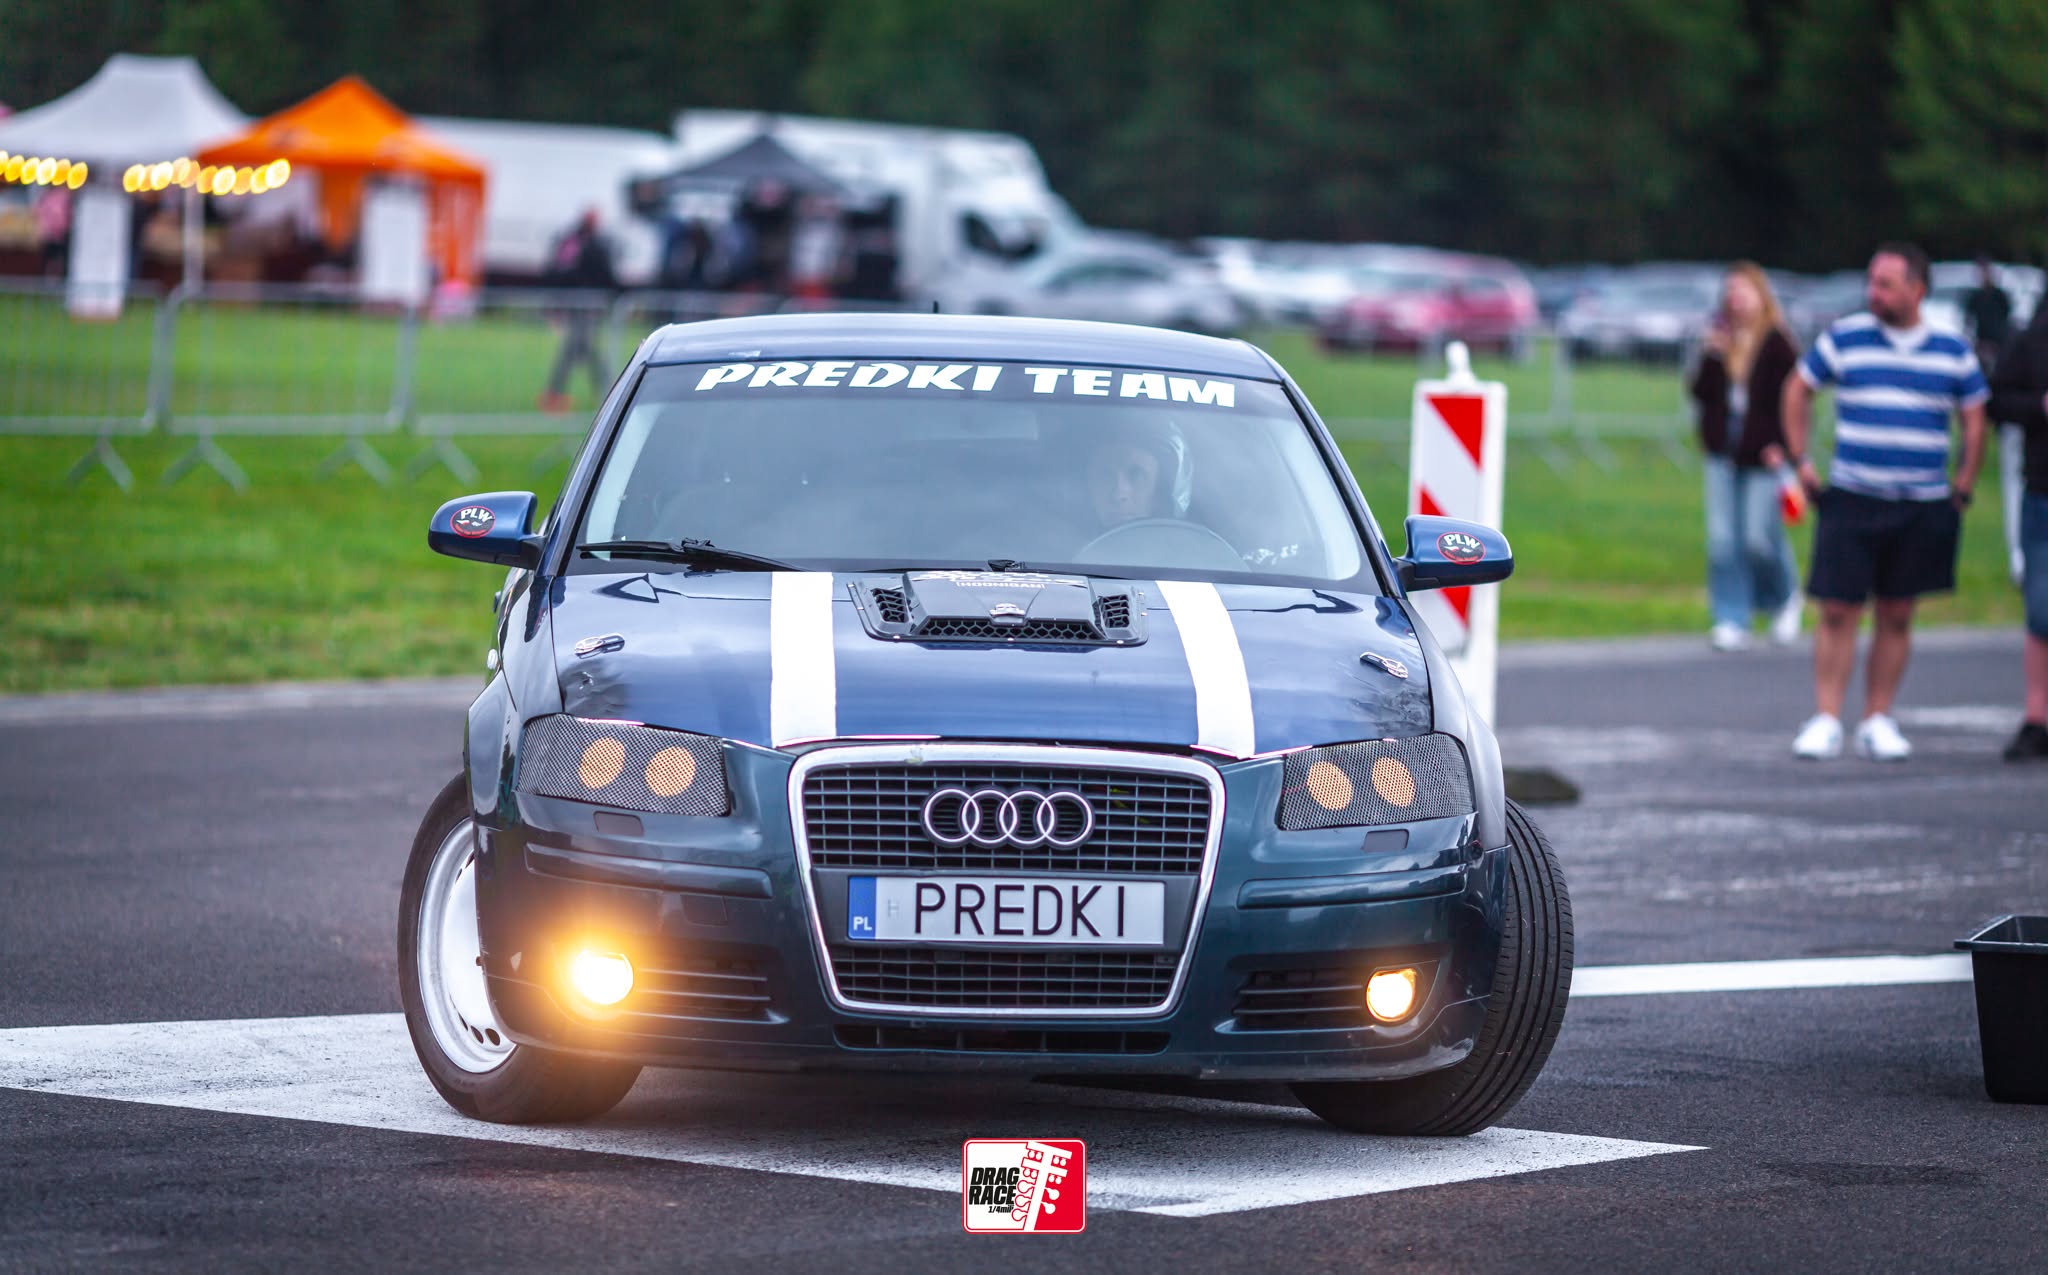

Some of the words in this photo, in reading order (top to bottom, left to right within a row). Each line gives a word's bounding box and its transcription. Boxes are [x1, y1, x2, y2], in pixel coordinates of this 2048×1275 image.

[694, 361, 1003, 392] PREDKI
[1023, 367, 1235, 408] TEAM
[460, 507, 493, 523] PLW
[1443, 533, 1481, 549] PLW
[914, 882, 1126, 937] PREDKI
[853, 916, 873, 932] PL
